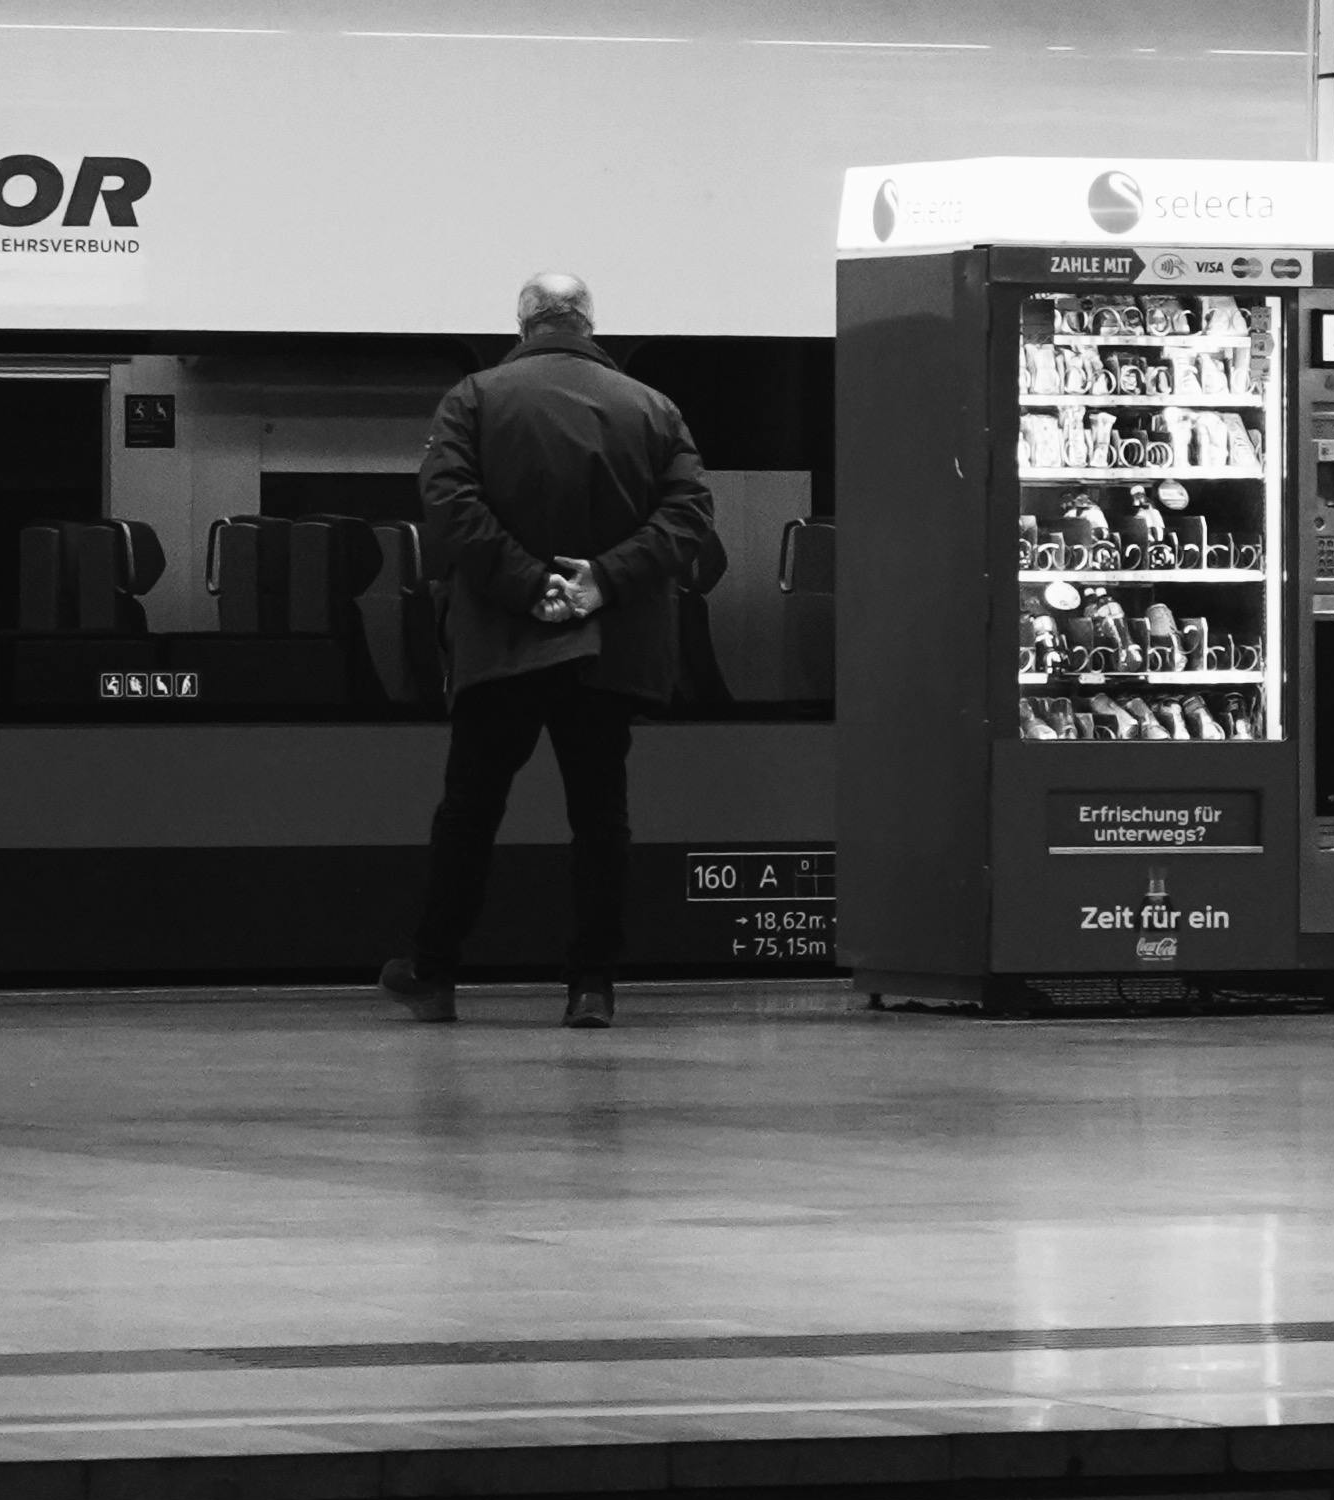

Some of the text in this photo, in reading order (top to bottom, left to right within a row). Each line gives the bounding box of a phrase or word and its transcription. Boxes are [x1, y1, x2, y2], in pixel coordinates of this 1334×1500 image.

[1155, 189, 1273, 219] selecta
[1051, 256, 1132, 274] ZAHLE MIT
[1195, 261, 1224, 273] VISA
[1079, 806, 1222, 825] Erfrischung für
[1094, 826, 1206, 845] unterwegs?
[694, 865, 736, 889] 160
[759, 865, 778, 888] A
[1081, 905, 1229, 929] Zeit für ein
[753, 937, 827, 958] 75,15m
